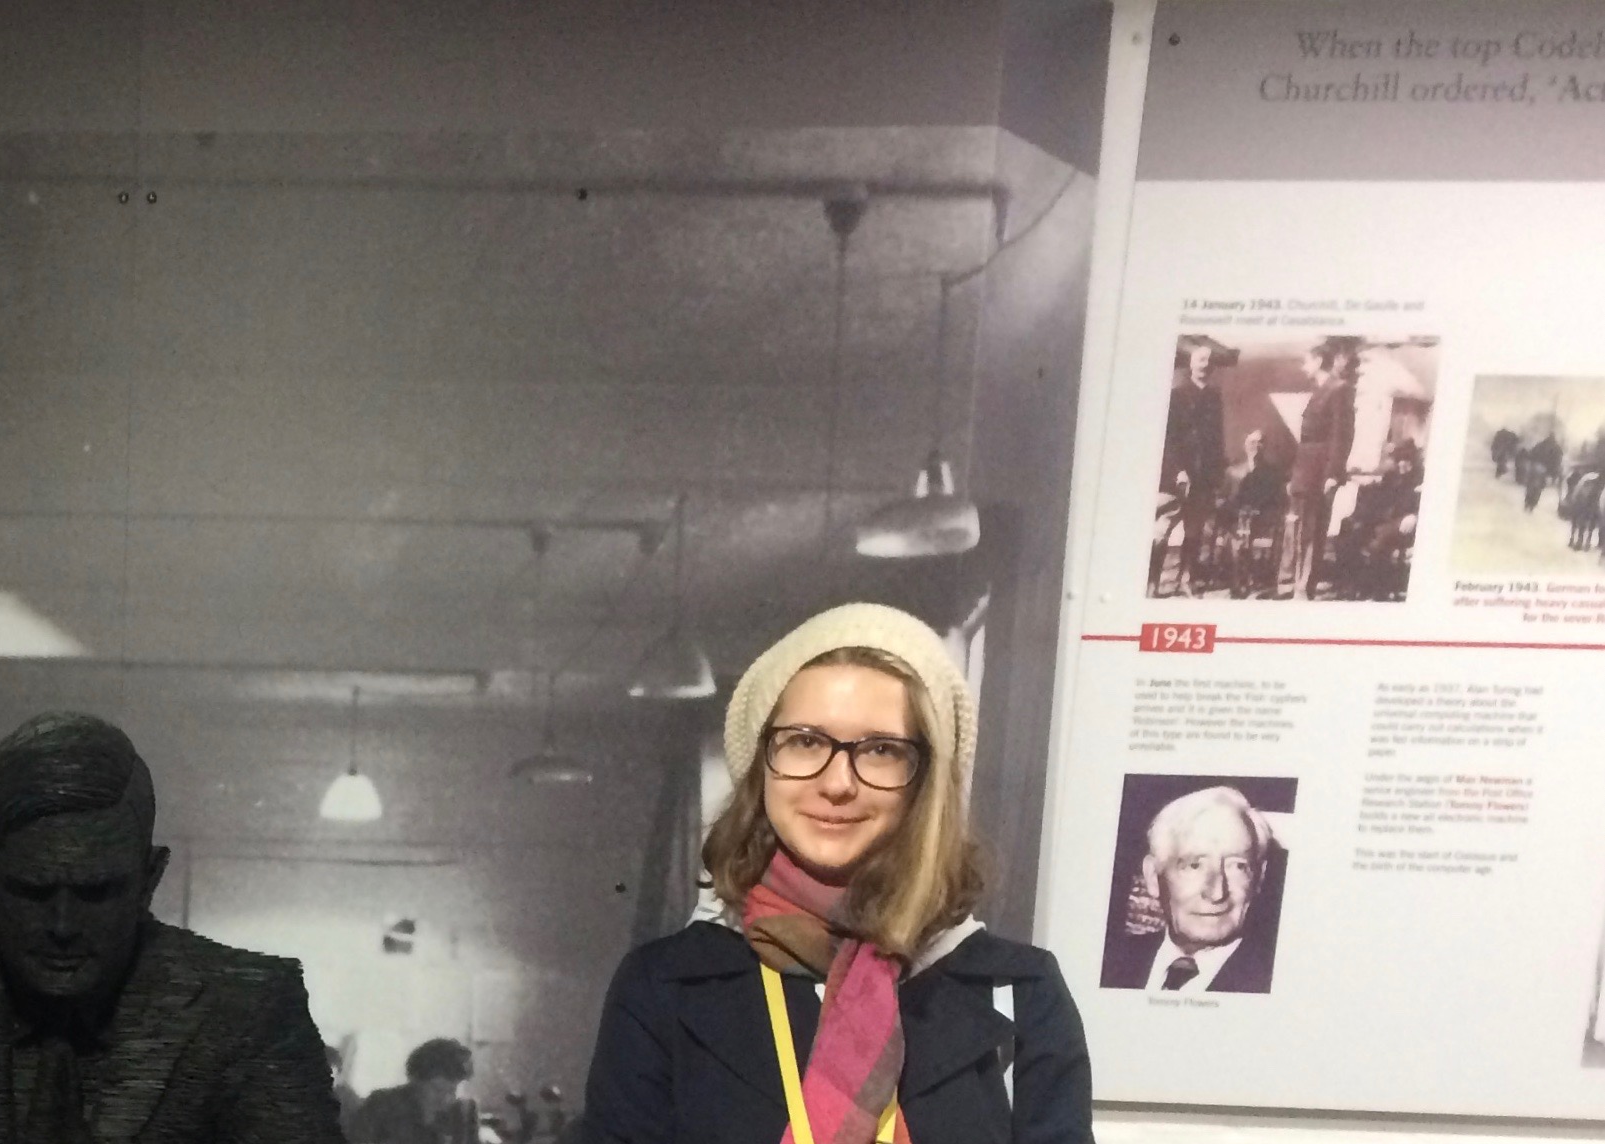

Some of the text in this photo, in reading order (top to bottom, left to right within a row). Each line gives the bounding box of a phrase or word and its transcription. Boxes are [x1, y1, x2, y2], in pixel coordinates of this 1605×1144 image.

[1298, 30, 1383, 59] When
[1396, 30, 1441, 59] the
[1451, 38, 1502, 67] top
[1260, 73, 1400, 102] Churchill
[1410, 73, 1536, 107] ordered,
[1184, 299, 1198, 309] 14
[1201, 300, 1245, 311] January
[1454, 581, 1504, 593] February
[1151, 626, 1207, 650] 1943
